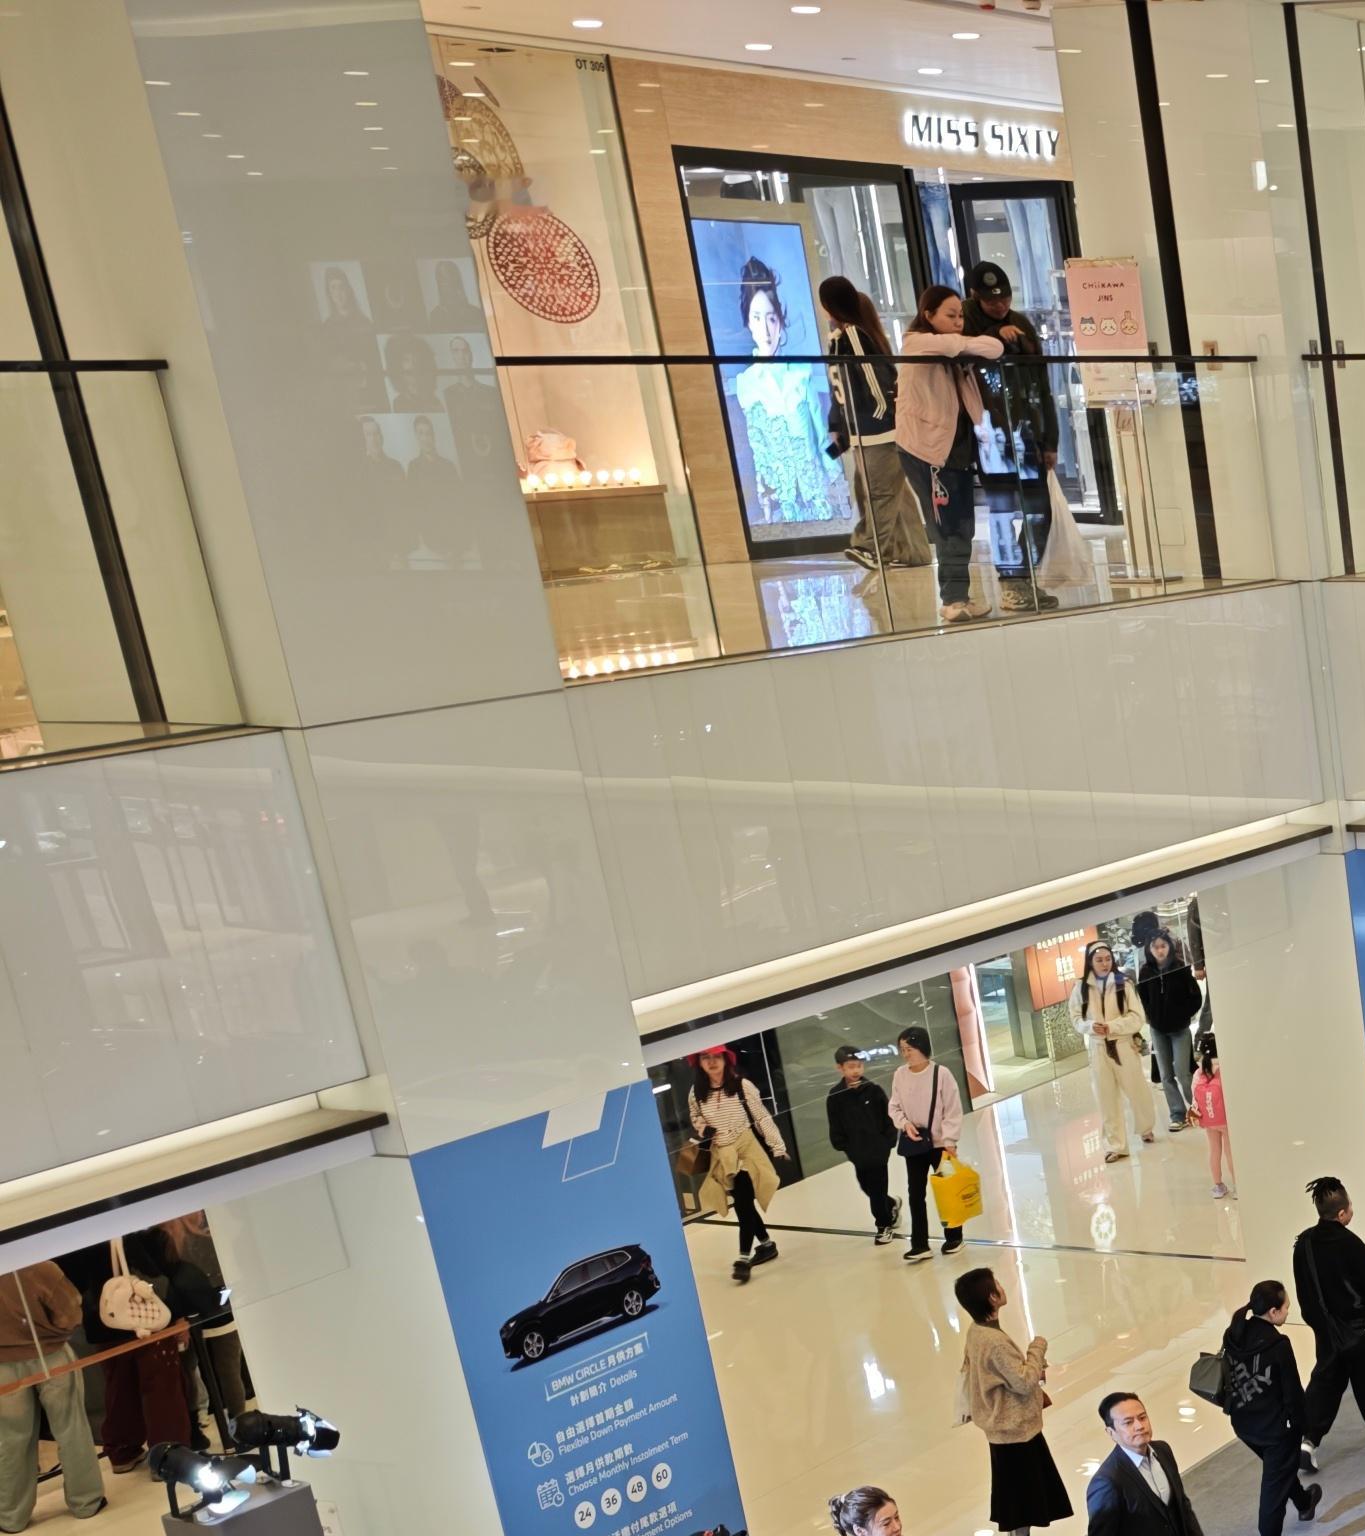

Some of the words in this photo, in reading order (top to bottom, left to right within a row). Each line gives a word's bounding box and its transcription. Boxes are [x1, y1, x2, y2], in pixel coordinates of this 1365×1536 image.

[909, 113, 979, 149] MISS
[986, 123, 1060, 158] SIXTY
[551, 1373, 574, 1391] BMW
[575, 1361, 607, 1382] CIRCLE
[609, 1369, 638, 1387] Details
[558, 1434, 590, 1455] Flexible
[590, 1424, 613, 1441] Down
[614, 1408, 648, 1431] Payment
[648, 1393, 678, 1413] Amount
[568, 1476, 599, 1496] Choose
[599, 1459, 630, 1481] Monthly
[670, 1431, 689, 1447] Term
[578, 1506, 592, 1521] 24
[604, 1495, 618, 1508] 36
[631, 1481, 644, 1495] 48
[655, 1468, 669, 1482] 60
[664, 1508, 693, 1530] Options
